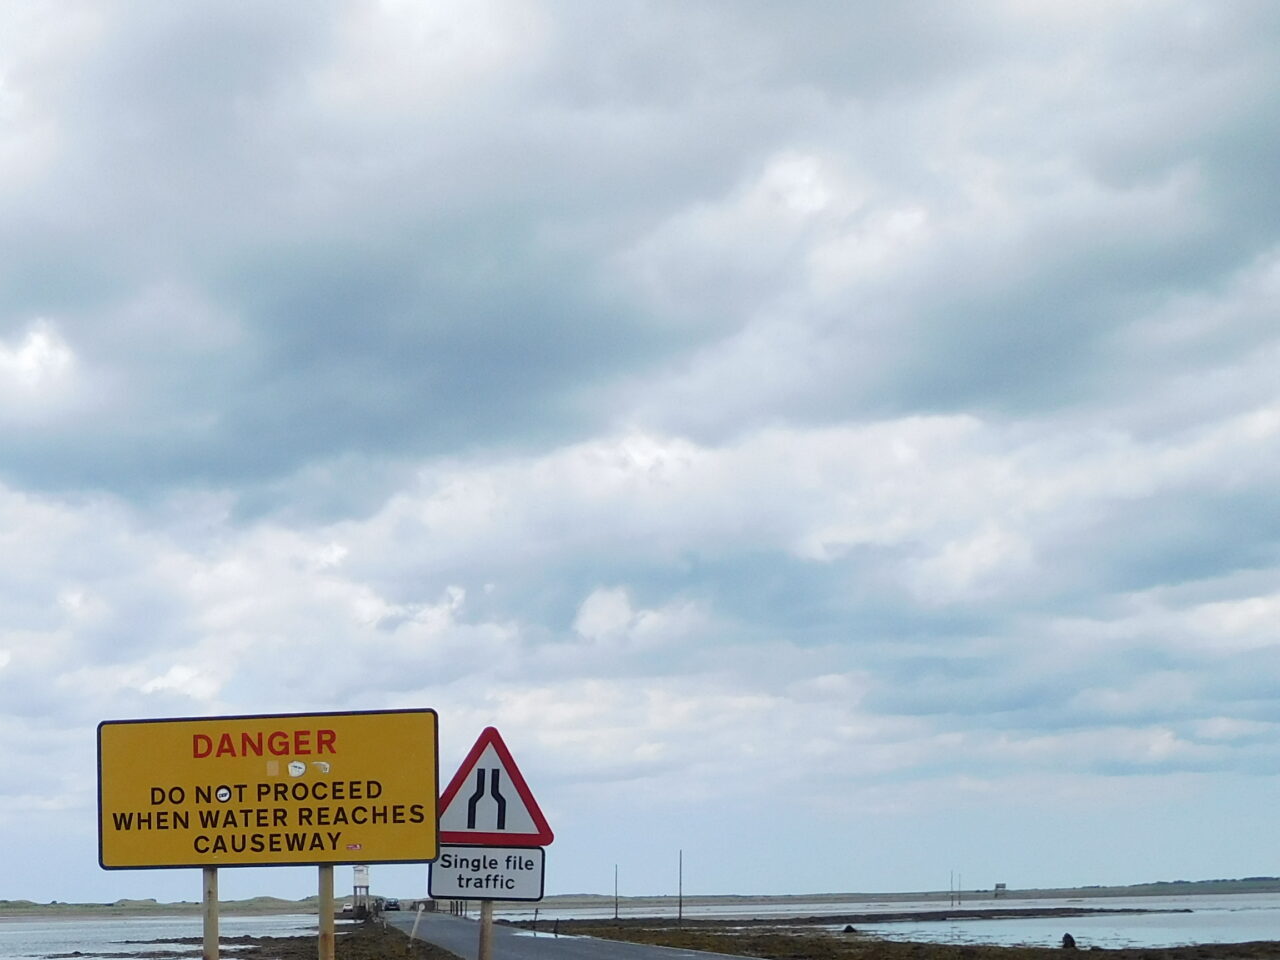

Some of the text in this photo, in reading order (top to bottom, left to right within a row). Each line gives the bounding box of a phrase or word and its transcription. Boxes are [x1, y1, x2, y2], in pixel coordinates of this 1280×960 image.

[193, 730, 337, 759] DANGER
[151, 781, 382, 805] DO NOT PROCEED
[112, 804, 425, 831] WHEN WATER REACHES
[194, 832, 342, 854] CAUSEWAY
[440, 854, 534, 872] Single file
[457, 874, 515, 889] traffic
